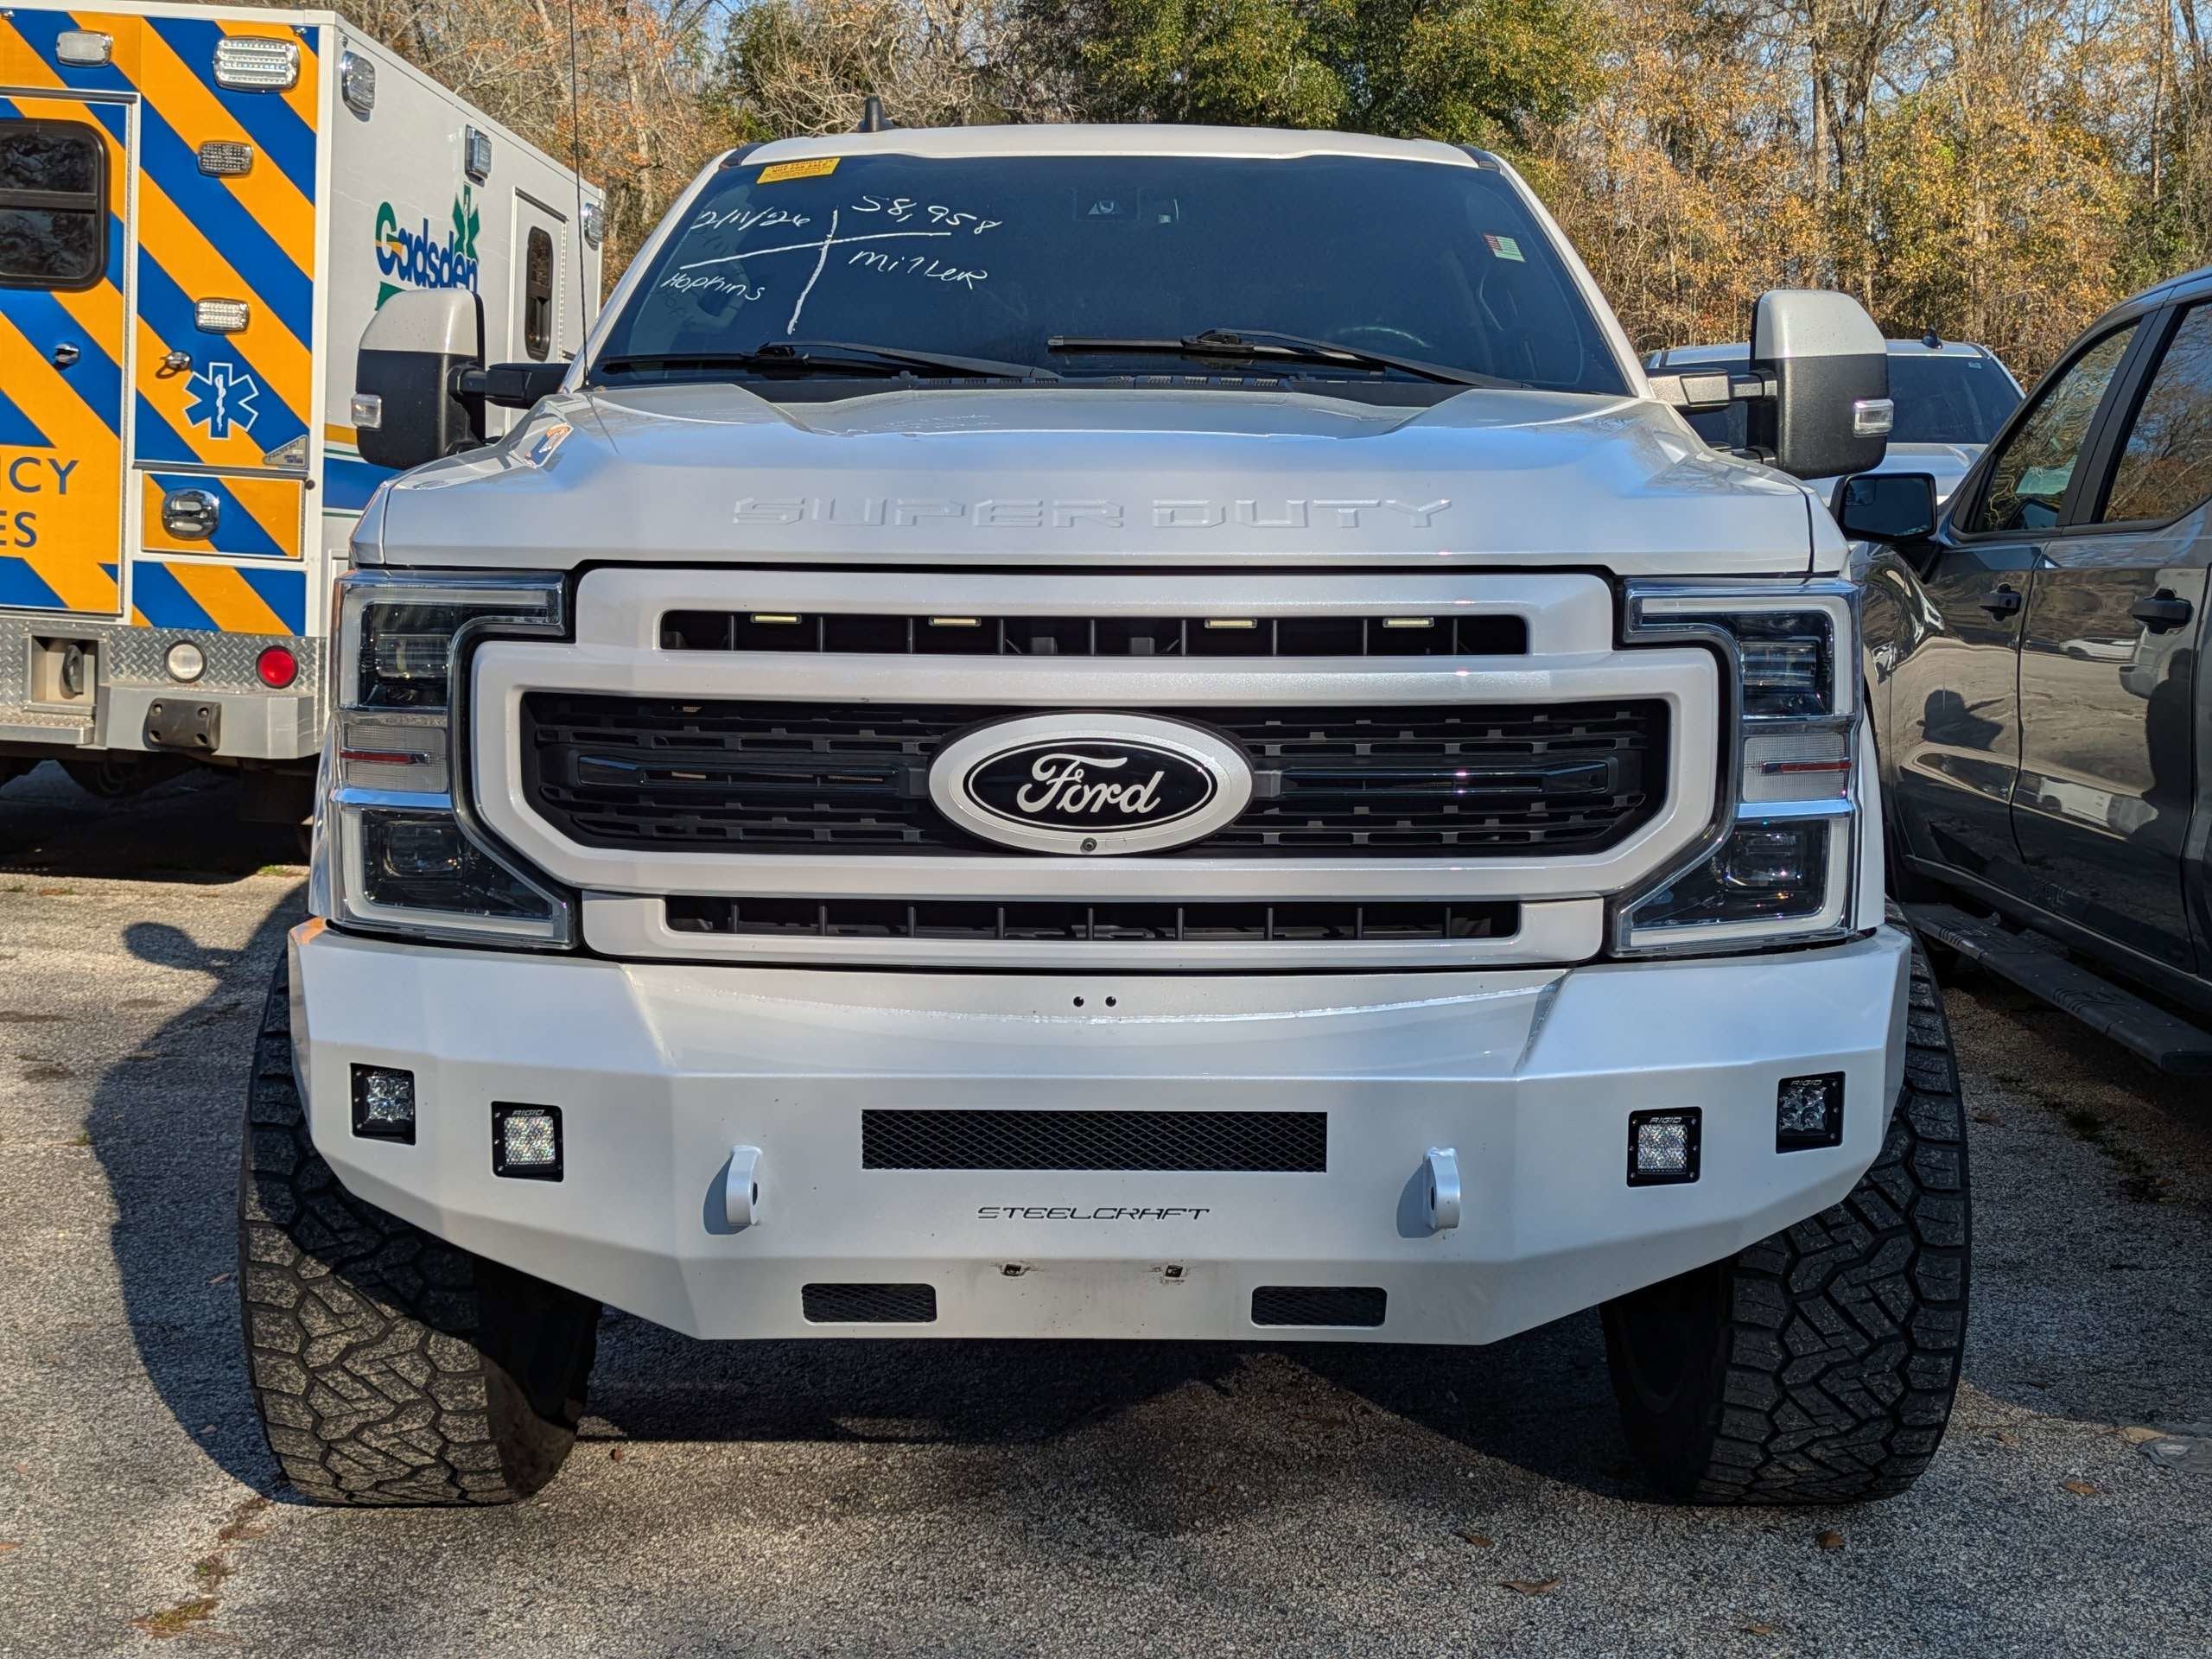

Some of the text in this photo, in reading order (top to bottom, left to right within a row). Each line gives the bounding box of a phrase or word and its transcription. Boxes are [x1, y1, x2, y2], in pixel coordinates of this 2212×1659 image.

[375, 201, 478, 293] Gadsden
[0, 456, 79, 495] CY
[733, 498, 1452, 528] SUPER DUTY
[1016, 753, 1165, 814] Ford
[977, 1206, 1211, 1220] STEELCRAFT
